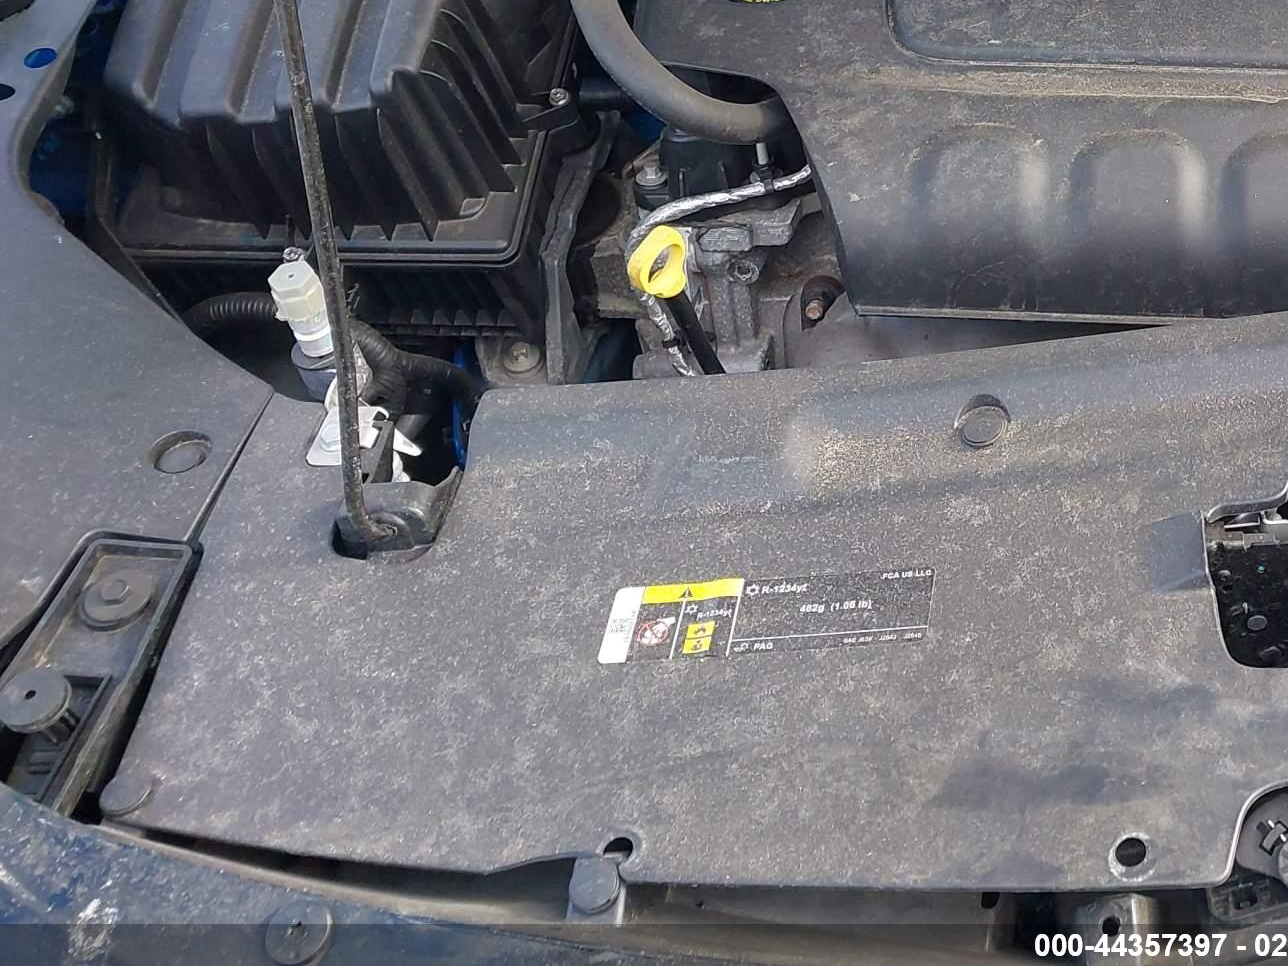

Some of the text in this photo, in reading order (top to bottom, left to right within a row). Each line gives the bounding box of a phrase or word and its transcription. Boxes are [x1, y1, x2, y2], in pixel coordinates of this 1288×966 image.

[882, 568, 932, 580] FCA US LLC
[753, 642, 774, 651] PAG
